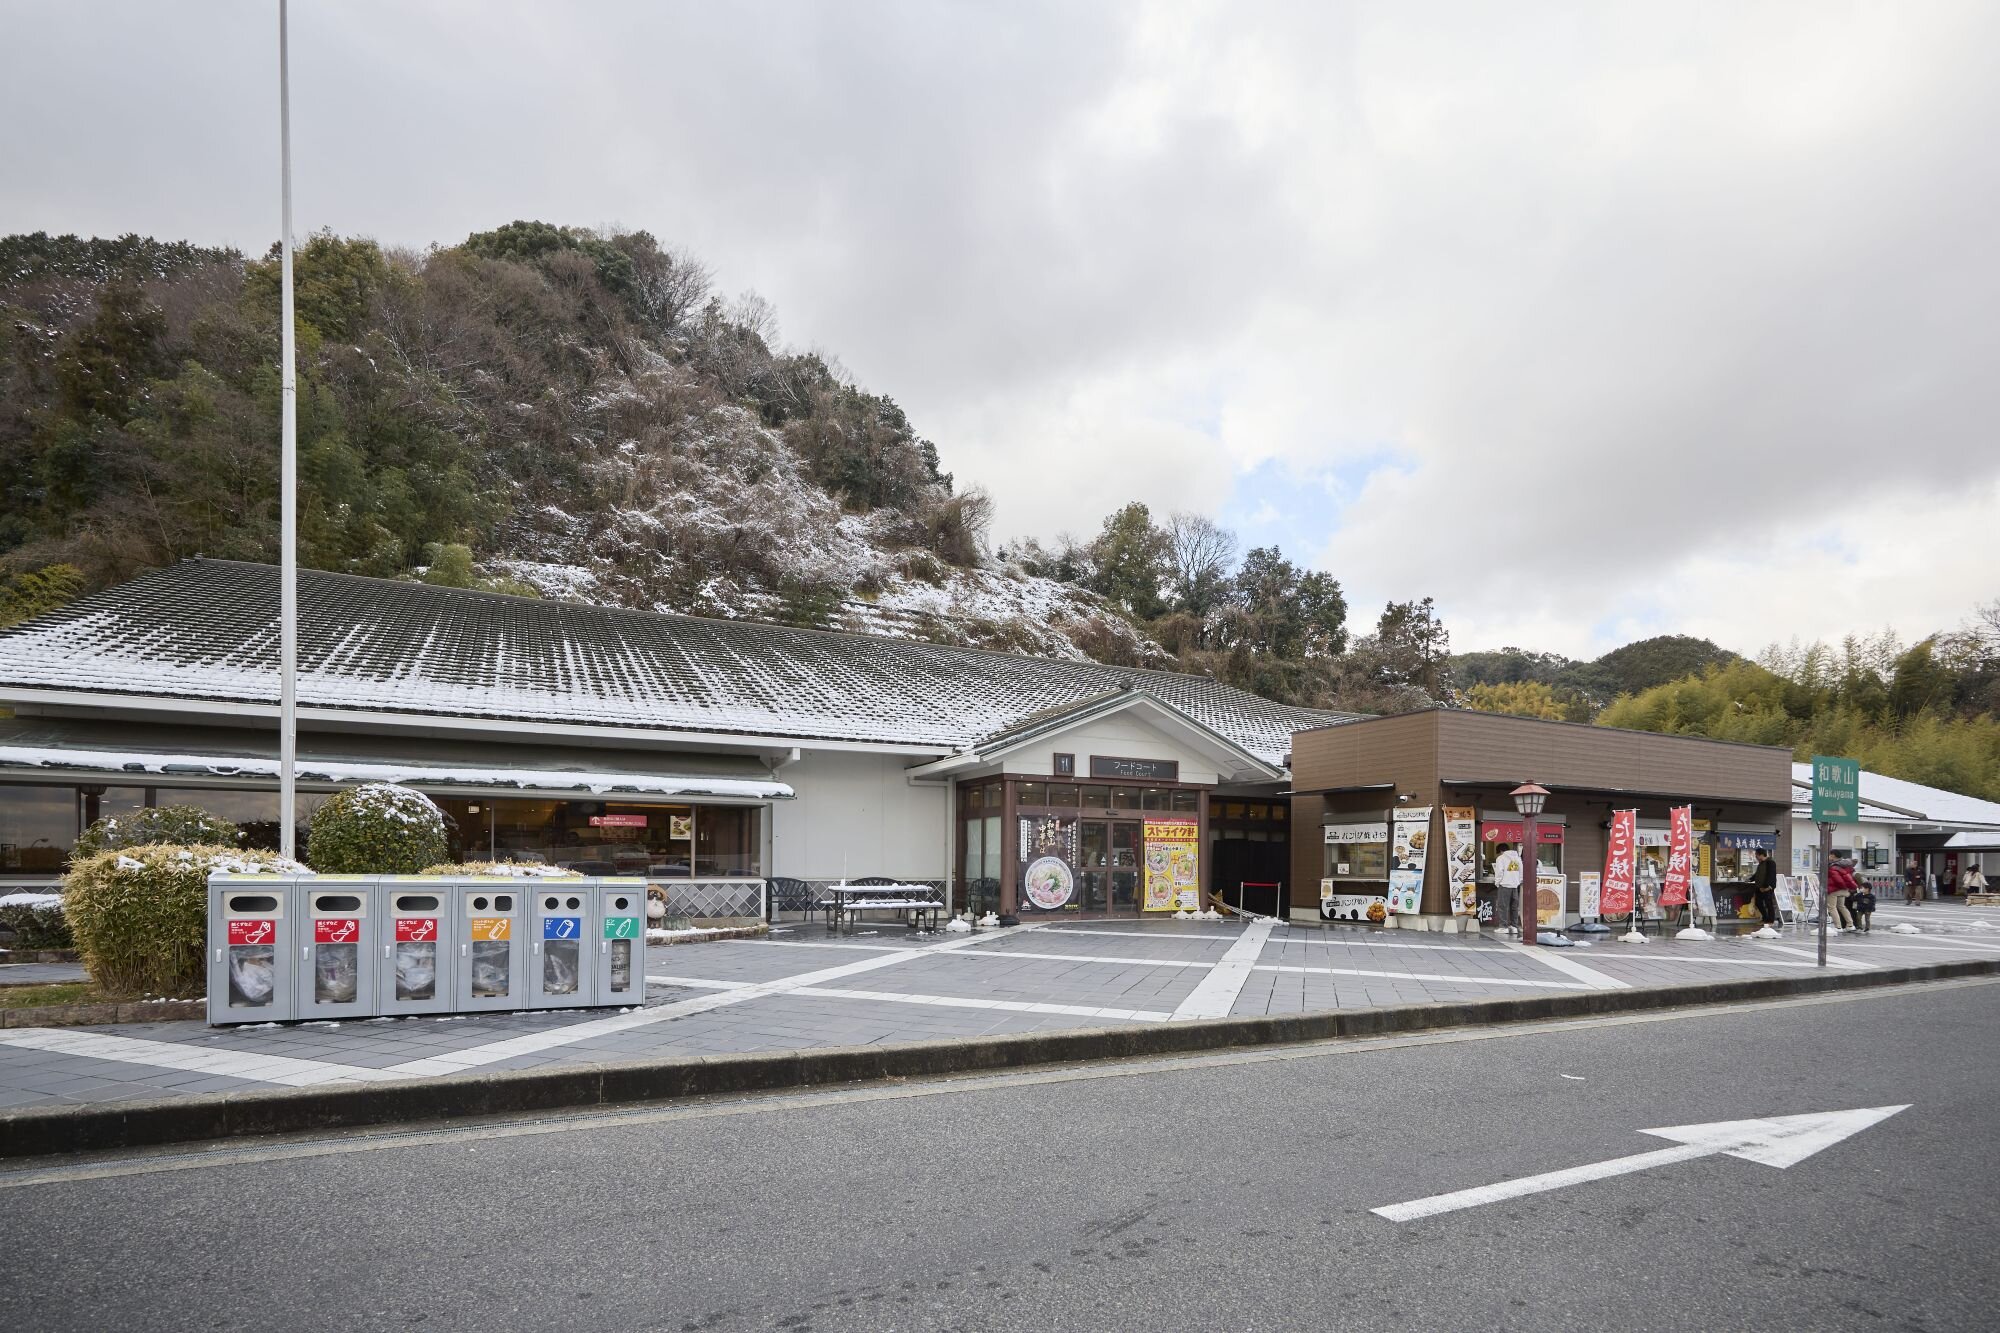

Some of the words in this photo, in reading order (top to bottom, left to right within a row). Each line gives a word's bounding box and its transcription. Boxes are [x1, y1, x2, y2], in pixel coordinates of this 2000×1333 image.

[1113, 761, 1157, 772] フードコート
[1818, 762, 1854, 785] 和歌山
[1818, 786, 1854, 800] Wakayama
[1147, 826, 1196, 837] ストライク軒
